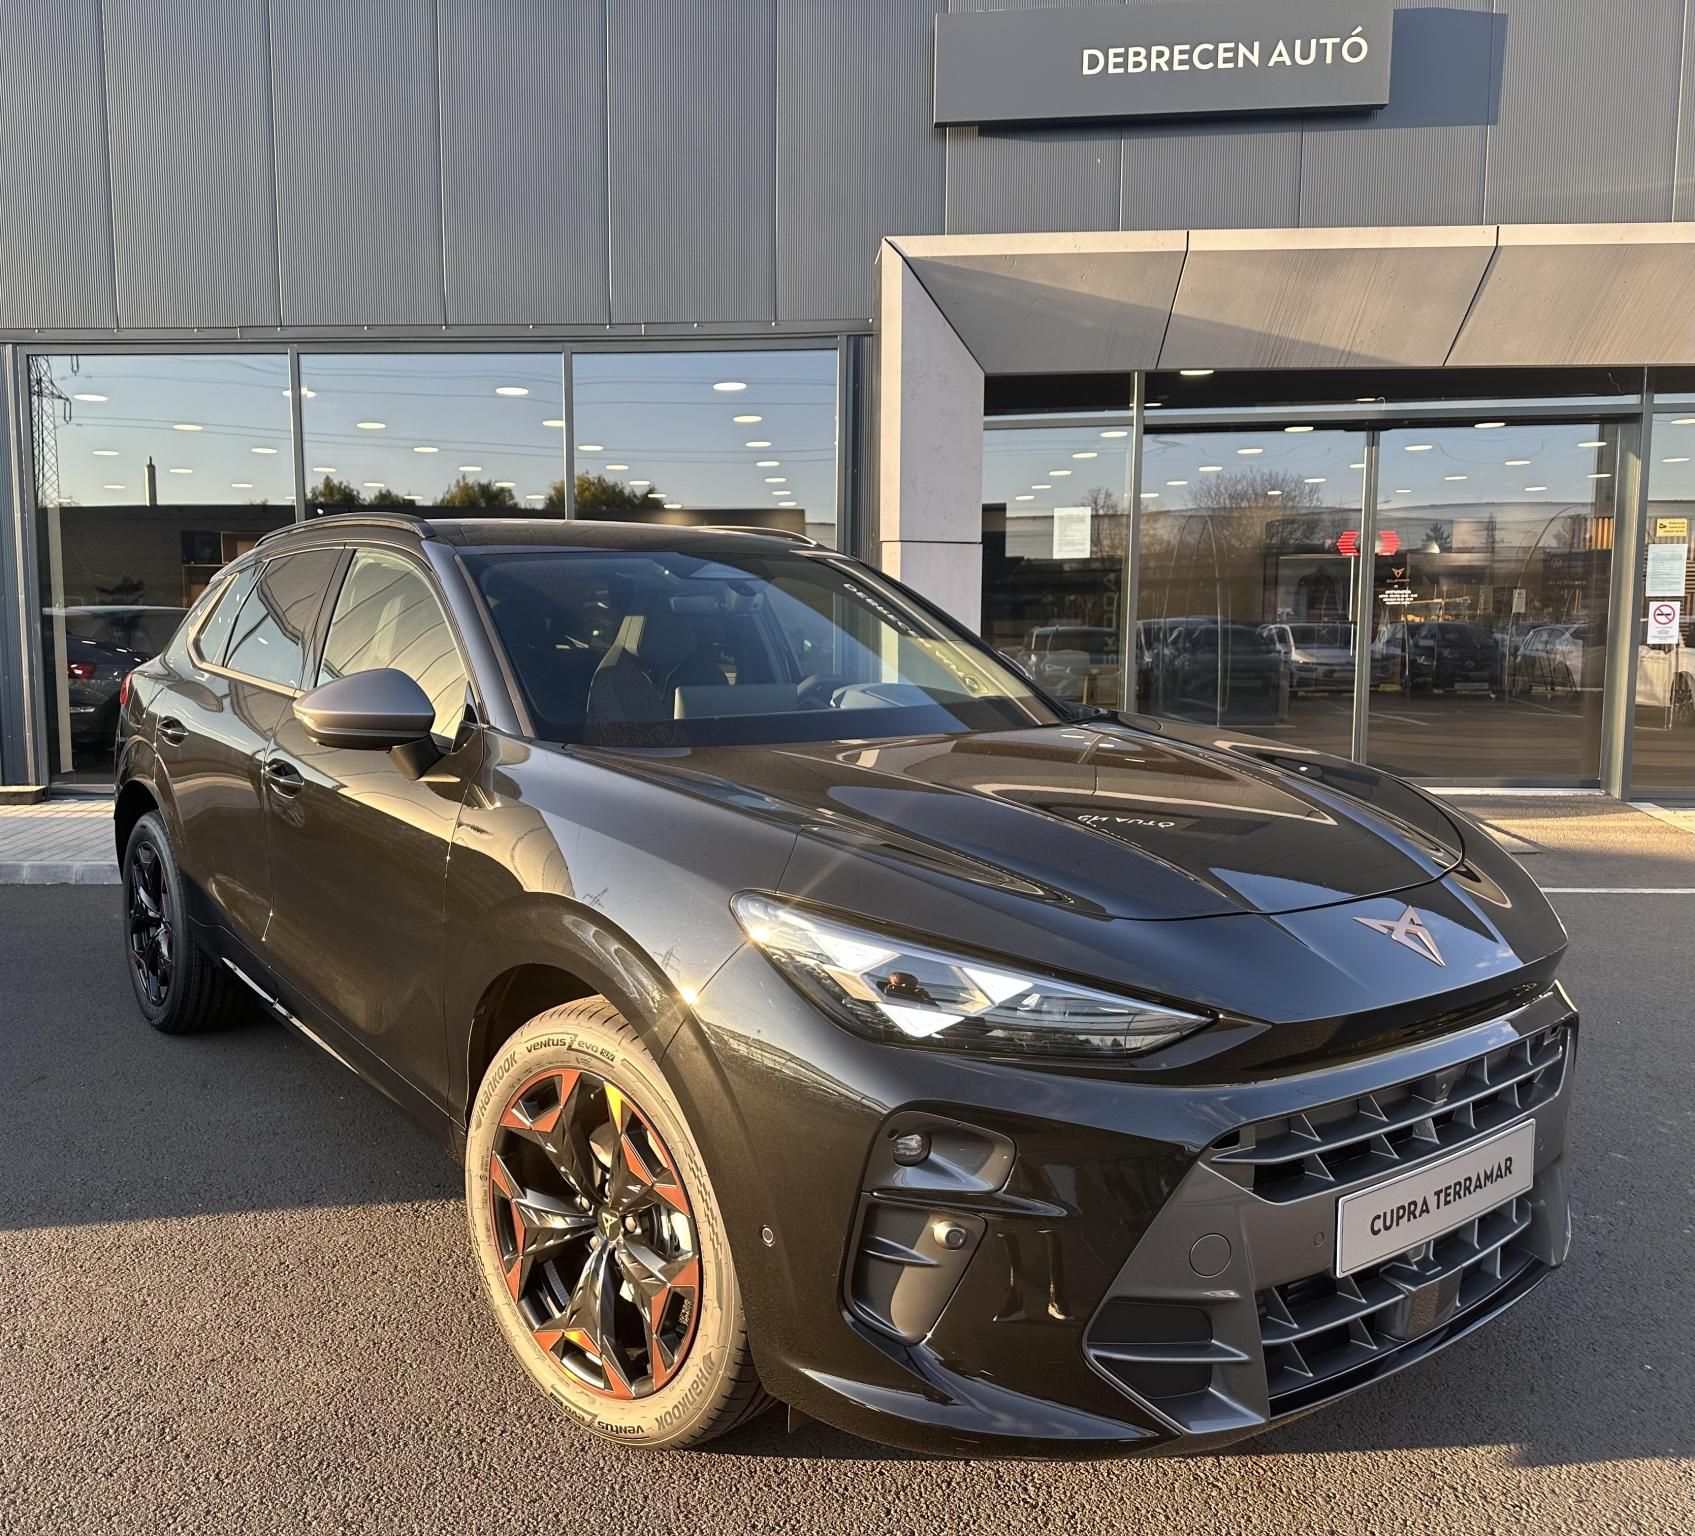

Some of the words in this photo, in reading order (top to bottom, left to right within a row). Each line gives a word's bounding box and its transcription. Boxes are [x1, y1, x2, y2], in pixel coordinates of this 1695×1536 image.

[1082, 41, 1260, 75] DEBRECEN
[1267, 25, 1369, 66] AUTÓ
[577, 1040, 599, 1053] evo
[1370, 1195, 1430, 1236] CUPRA
[1433, 1156, 1513, 1210] TERRAMAR
